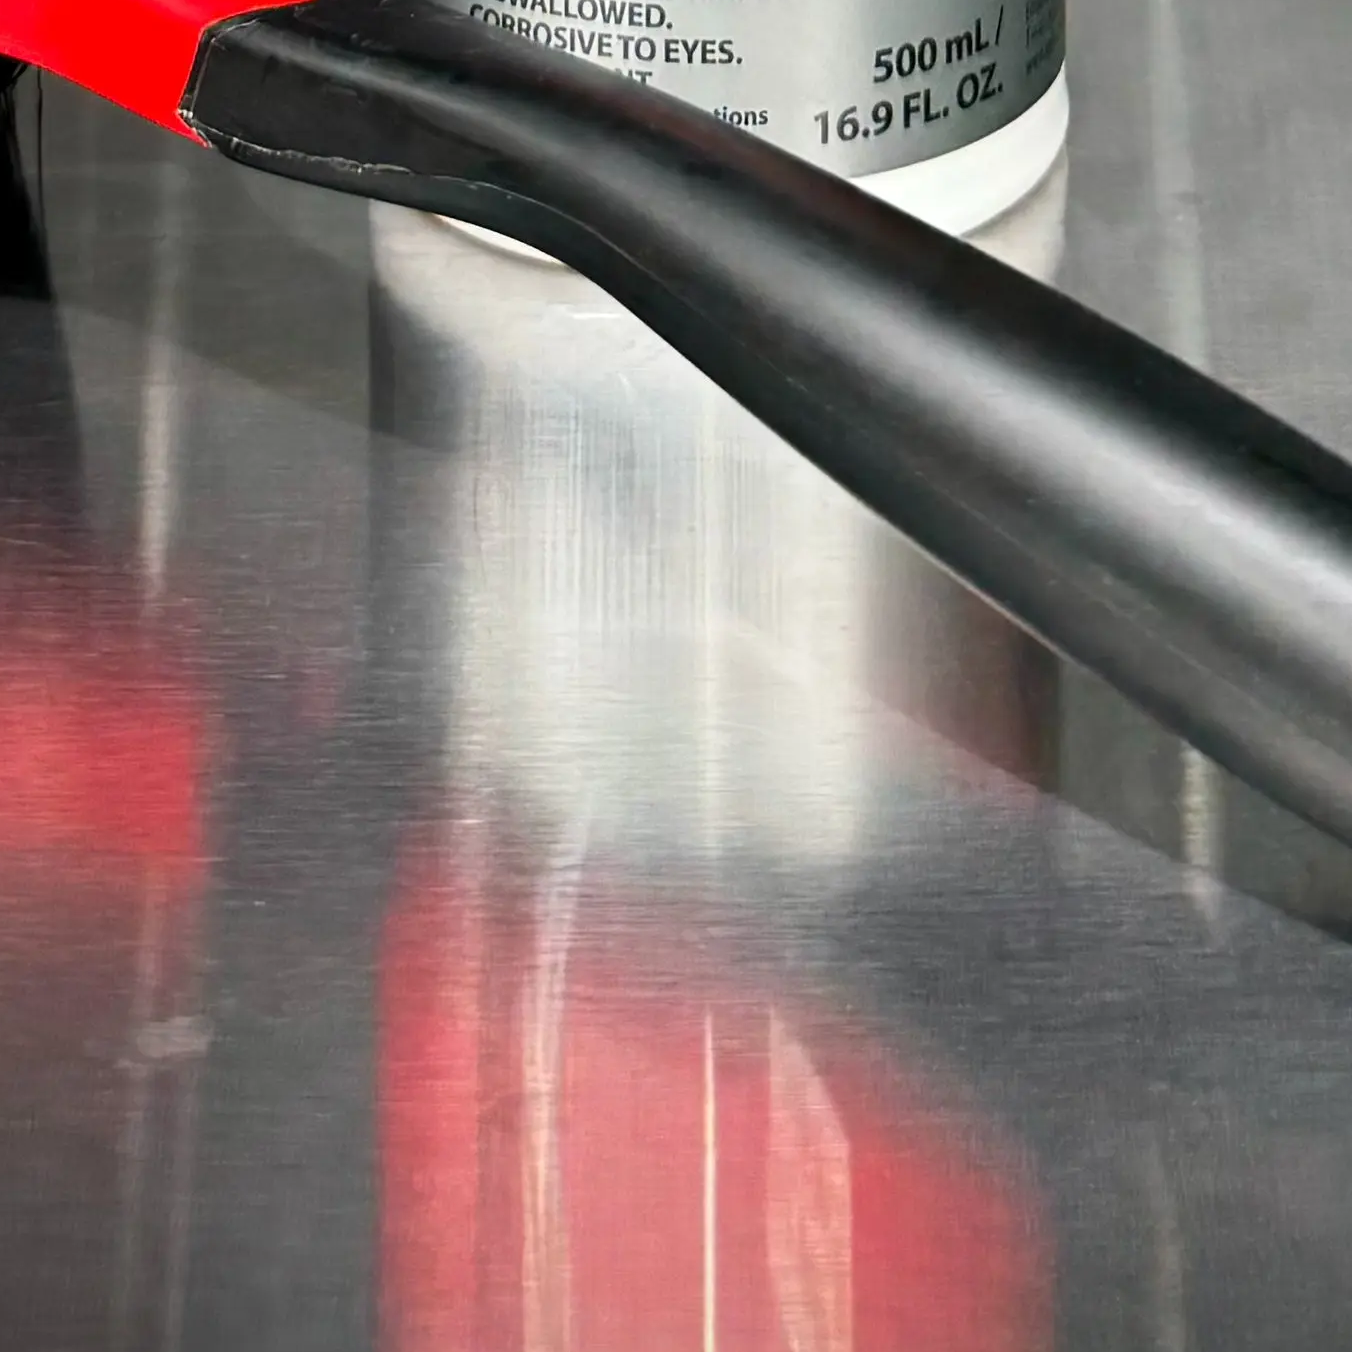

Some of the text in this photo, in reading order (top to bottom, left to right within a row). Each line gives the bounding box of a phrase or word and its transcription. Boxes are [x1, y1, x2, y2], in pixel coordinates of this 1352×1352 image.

[617, 33, 657, 62] TO
[664, 38, 743, 65] EYES.
[873, 36, 938, 83] 500
[945, 17, 990, 64] mL
[814, 61, 1003, 145] 16.9 FL. OZ.
